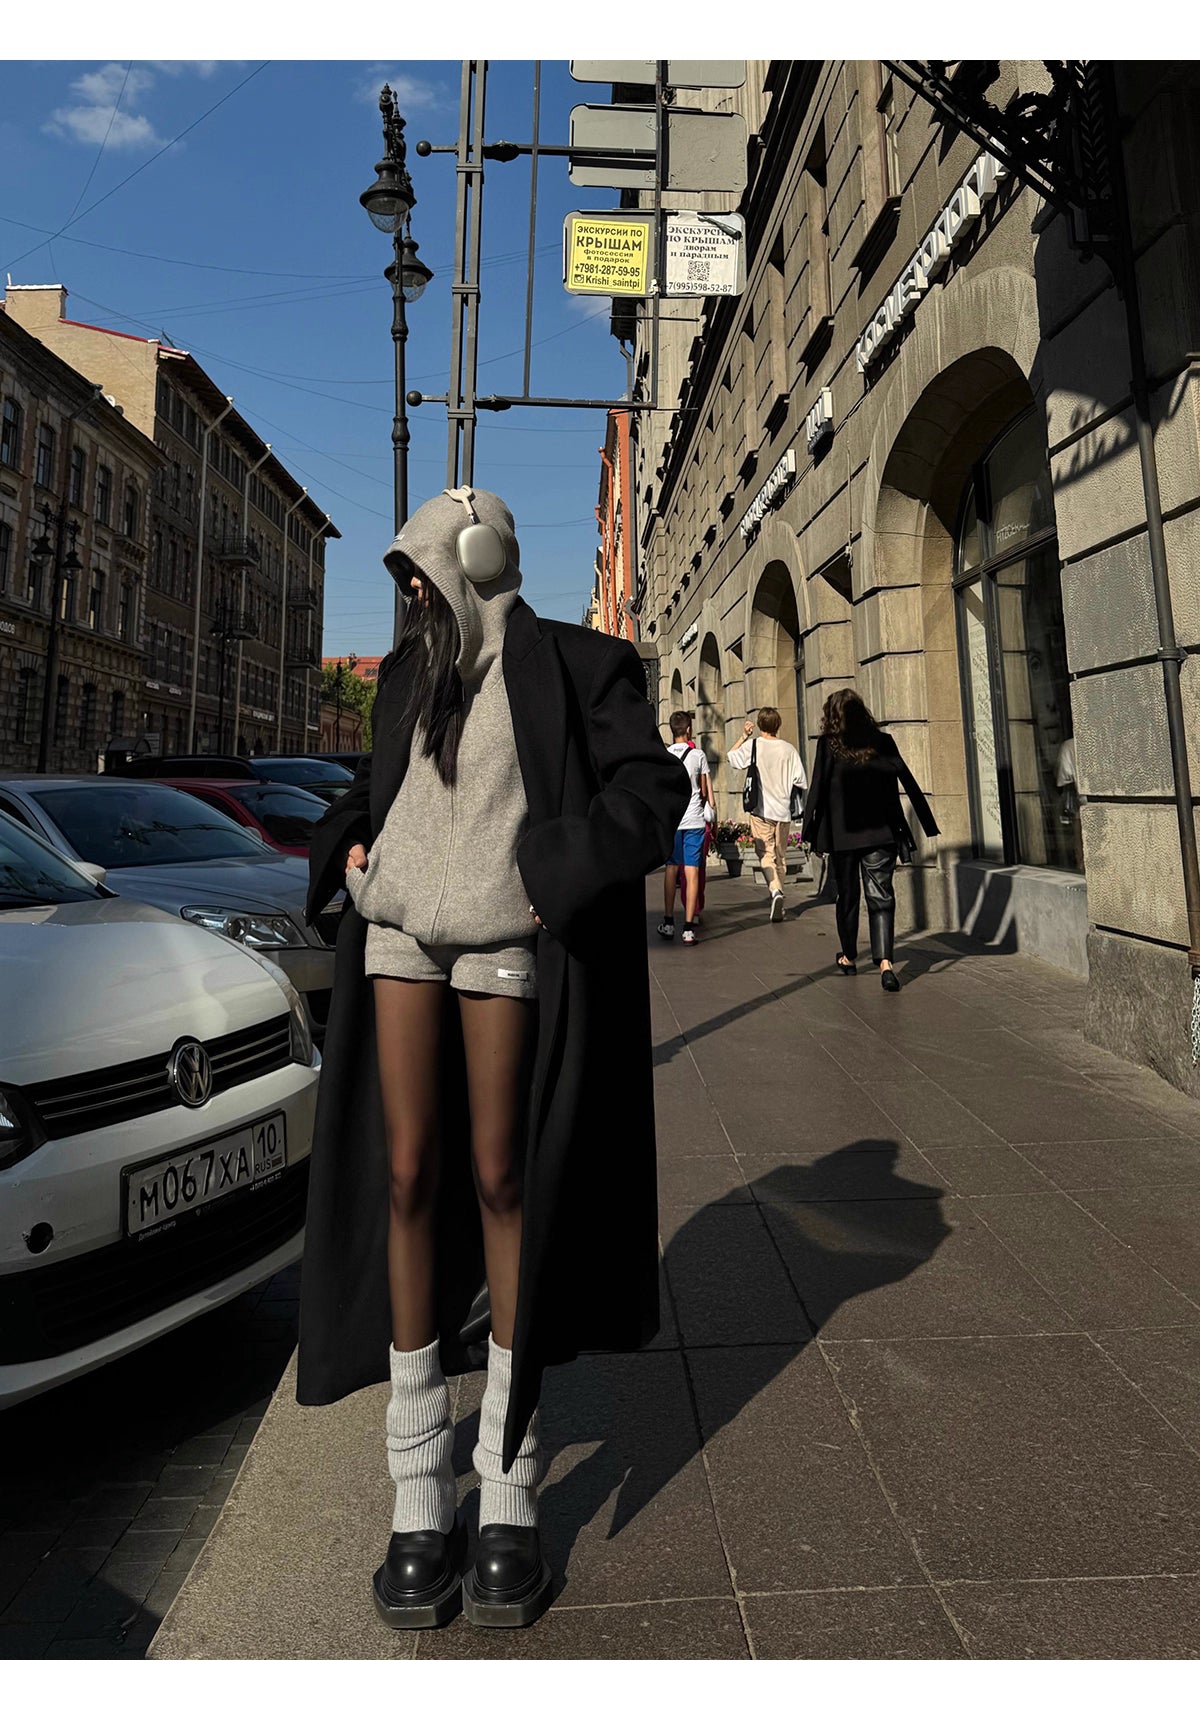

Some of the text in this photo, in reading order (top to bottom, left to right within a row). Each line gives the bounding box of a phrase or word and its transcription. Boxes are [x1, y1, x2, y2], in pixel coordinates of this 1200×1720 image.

[577, 225, 643, 237] ЭКСКУРСИИ ПО
[576, 235, 642, 251] КРЫШАМ
[684, 236, 735, 245] КРЫШАМ
[583, 248, 634, 258] фотосессия
[594, 255, 630, 264] подарок
[679, 251, 729, 260] парадным
[856, 149, 1007, 374] КОСМЕТОЛОГИ
[575, 262, 641, 277] +7981-287-59-95
[257, 1123, 278, 1158] 10
[255, 1158, 272, 1174] RUS
